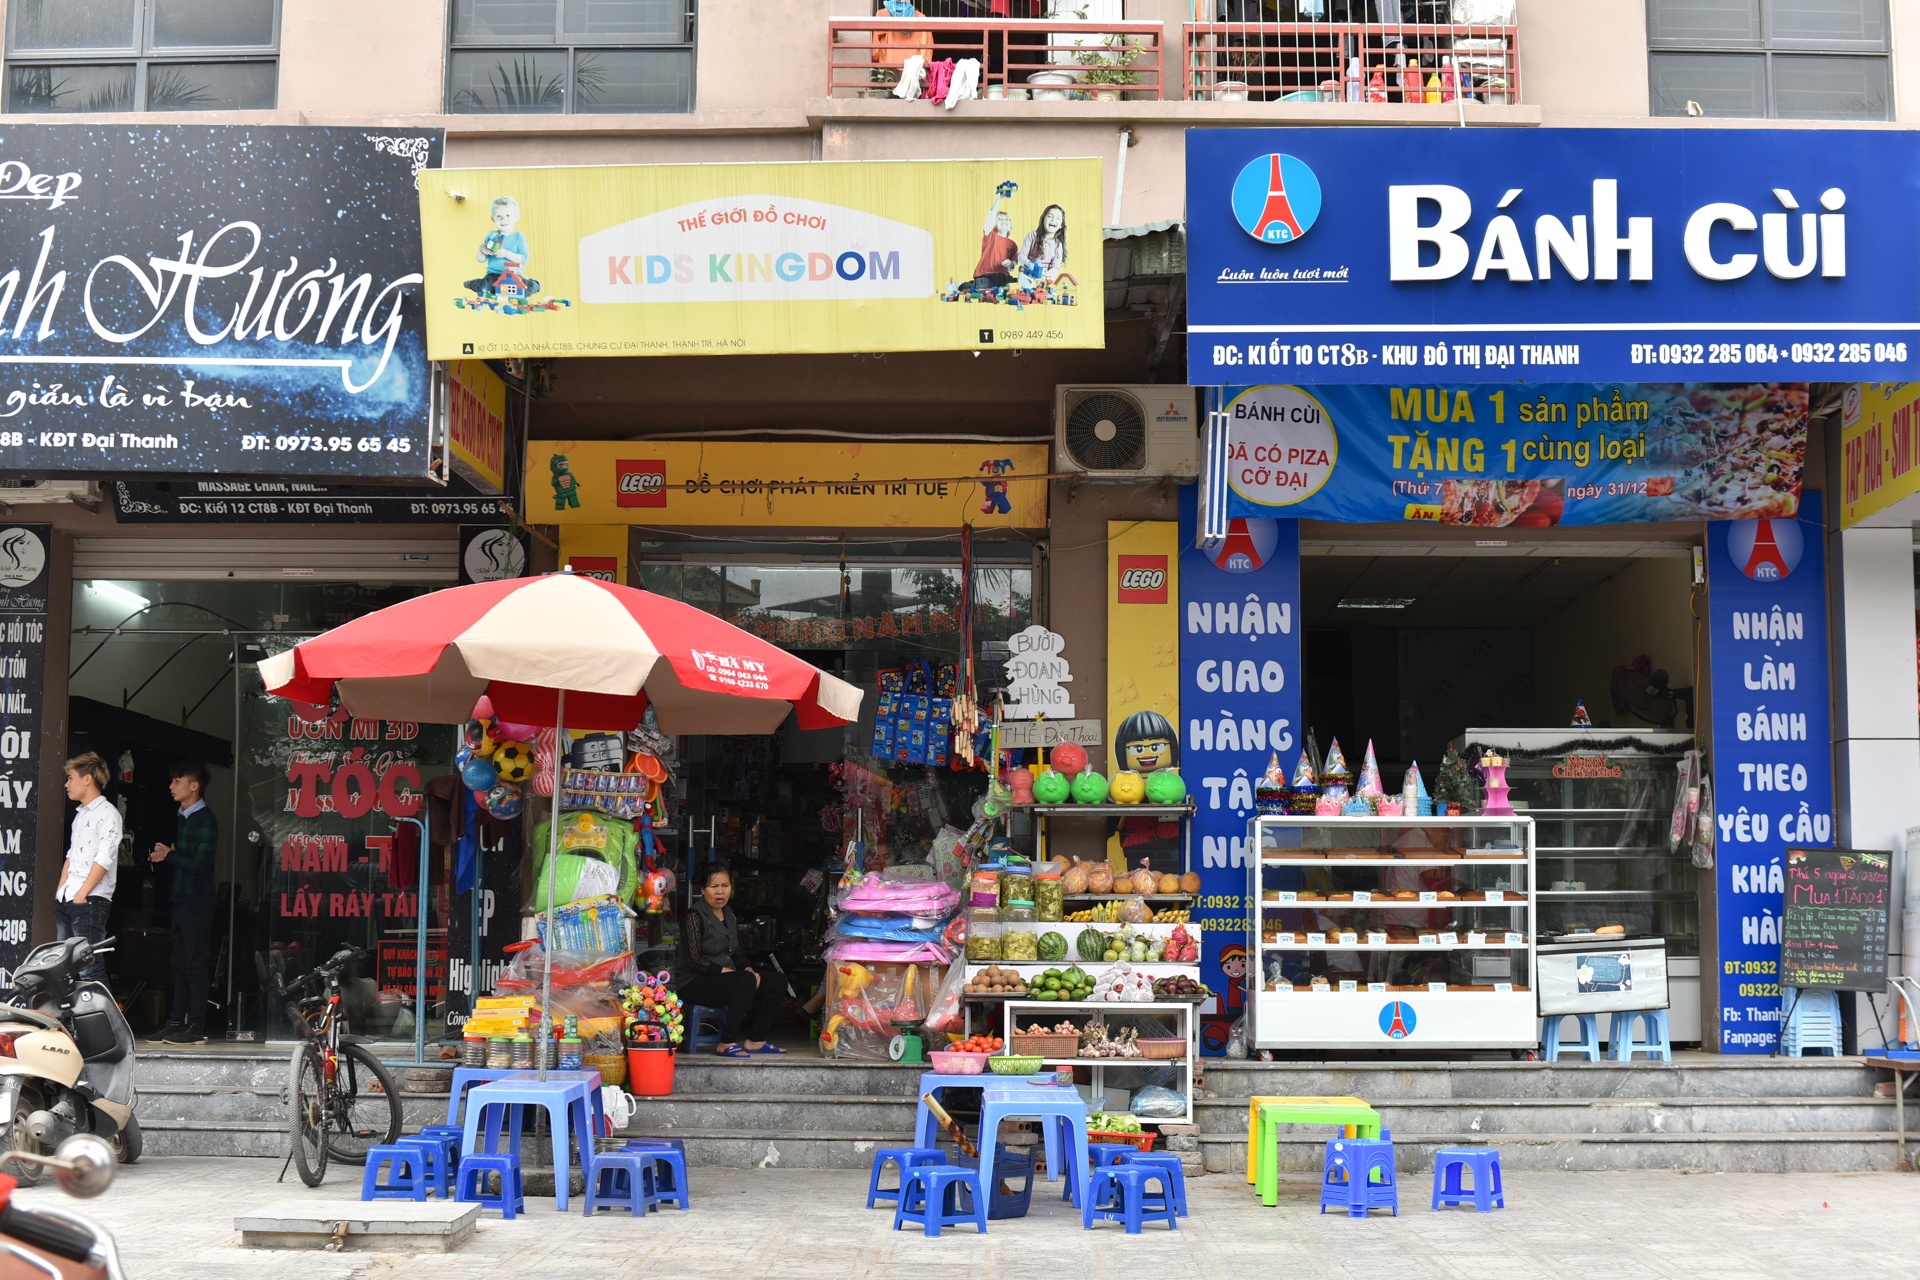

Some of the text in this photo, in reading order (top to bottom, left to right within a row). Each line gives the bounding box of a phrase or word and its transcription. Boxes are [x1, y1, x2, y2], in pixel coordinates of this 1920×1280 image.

[677, 204, 827, 233] THẾ GIỚI ĐỒ CHƠI
[1390, 179, 1654, 282] BÁNH
[1267, 229, 1290, 240] KTC
[608, 251, 900, 285] KIDS KINGDOM
[1217, 267, 1256, 281] Luôn
[1293, 267, 1321, 280] tươi
[1323, 266, 1349, 279] mới
[84, 220, 423, 393] Hương
[576, 342, 608, 351] CHUNG
[672, 340, 699, 349] THANH
[716, 338, 728, 348] HÀ
[1000, 331, 1063, 340] 0989 449 456
[1213, 345, 1243, 365] ĐC:
[1293, 345, 1313, 365] 10
[1317, 343, 1369, 367] CT8B
[1382, 345, 1418, 366] KHU
[1423, 341, 1448, 366] ĐÔ
[1452, 345, 1481, 369] THỊ
[1485, 345, 1515, 369] ĐẠI
[1520, 345, 1580, 366] THANH
[1708, 343, 1741, 364] 285
[1791, 343, 1835, 363] 0932
[1838, 343, 1870, 363] 285
[1874, 343, 1907, 363] 046
[99, 376, 136, 408] là
[142, 385, 177, 408] vì
[180, 382, 253, 412] bạn
[1235, 401, 1320, 424] BÁNH CÙI
[1389, 388, 1650, 429] MUA 1 sản phẩm
[40, 433, 178, 453] KĐT Đại Thanh
[242, 436, 411, 453] ĐT: 0973.95 65 45
[1254, 444, 1330, 466] CÓ PIZA
[1388, 429, 1646, 478] TẶNG 1 cùng loại
[1846, 435, 1862, 518] TẠP
[1864, 410, 1883, 496] HÓA
[1892, 403, 1911, 480] SIM
[618, 474, 662, 493] LEGO
[719, 478, 766, 495] CHƠI
[769, 477, 818, 495] PHÁT
[822, 472, 877, 495] TRIỂN
[884, 478, 910, 496] TRÍ
[914, 477, 949, 500] TUỆ
[1241, 466, 1308, 491] CỠ ĐẠI
[1392, 479, 1431, 496] (Thứ
[1567, 483, 1601, 498] ngày
[1607, 481, 1648, 496] 31/12
[180, 500, 373, 516] ĐC: Kiốt 12 CT8B KĐT Đại Thanh
[411, 503, 497, 514] ĐT: 0973.95 65
[1411, 507, 1434, 520] ĂN
[1229, 558, 1250, 569] KTC
[1757, 567, 1777, 578] KTC
[1121, 569, 1166, 589] LEGO
[1188, 593, 1291, 642] NHẬN
[1733, 604, 1803, 646] NHẬN
[25, 618, 43, 643] TÓC
[742, 660, 765, 673] MY
[1196, 660, 1284, 693] GIAO
[1744, 655, 1796, 690] LÀM
[385, 719, 420, 741] 3D
[1190, 709, 1293, 752] HÀNG
[1736, 705, 1807, 741] BÁNH
[288, 746, 421, 819] TÓC
[1738, 763, 1808, 792] THEO
[1202, 767, 1261, 818] TẬ
[1718, 801, 1831, 842] YÊU CẦU
[281, 842, 349, 873] NAM
[1814, 867, 1821, 880] 5
[280, 884, 323, 917] LẤY
[329, 889, 375, 917] RÁY
[1742, 908, 1783, 944] HÀ
[1724, 1008, 1741, 1022] Fb:
[42, 1045, 71, 1055] LEAD
[1724, 1030, 1777, 1047] Fanpage:
